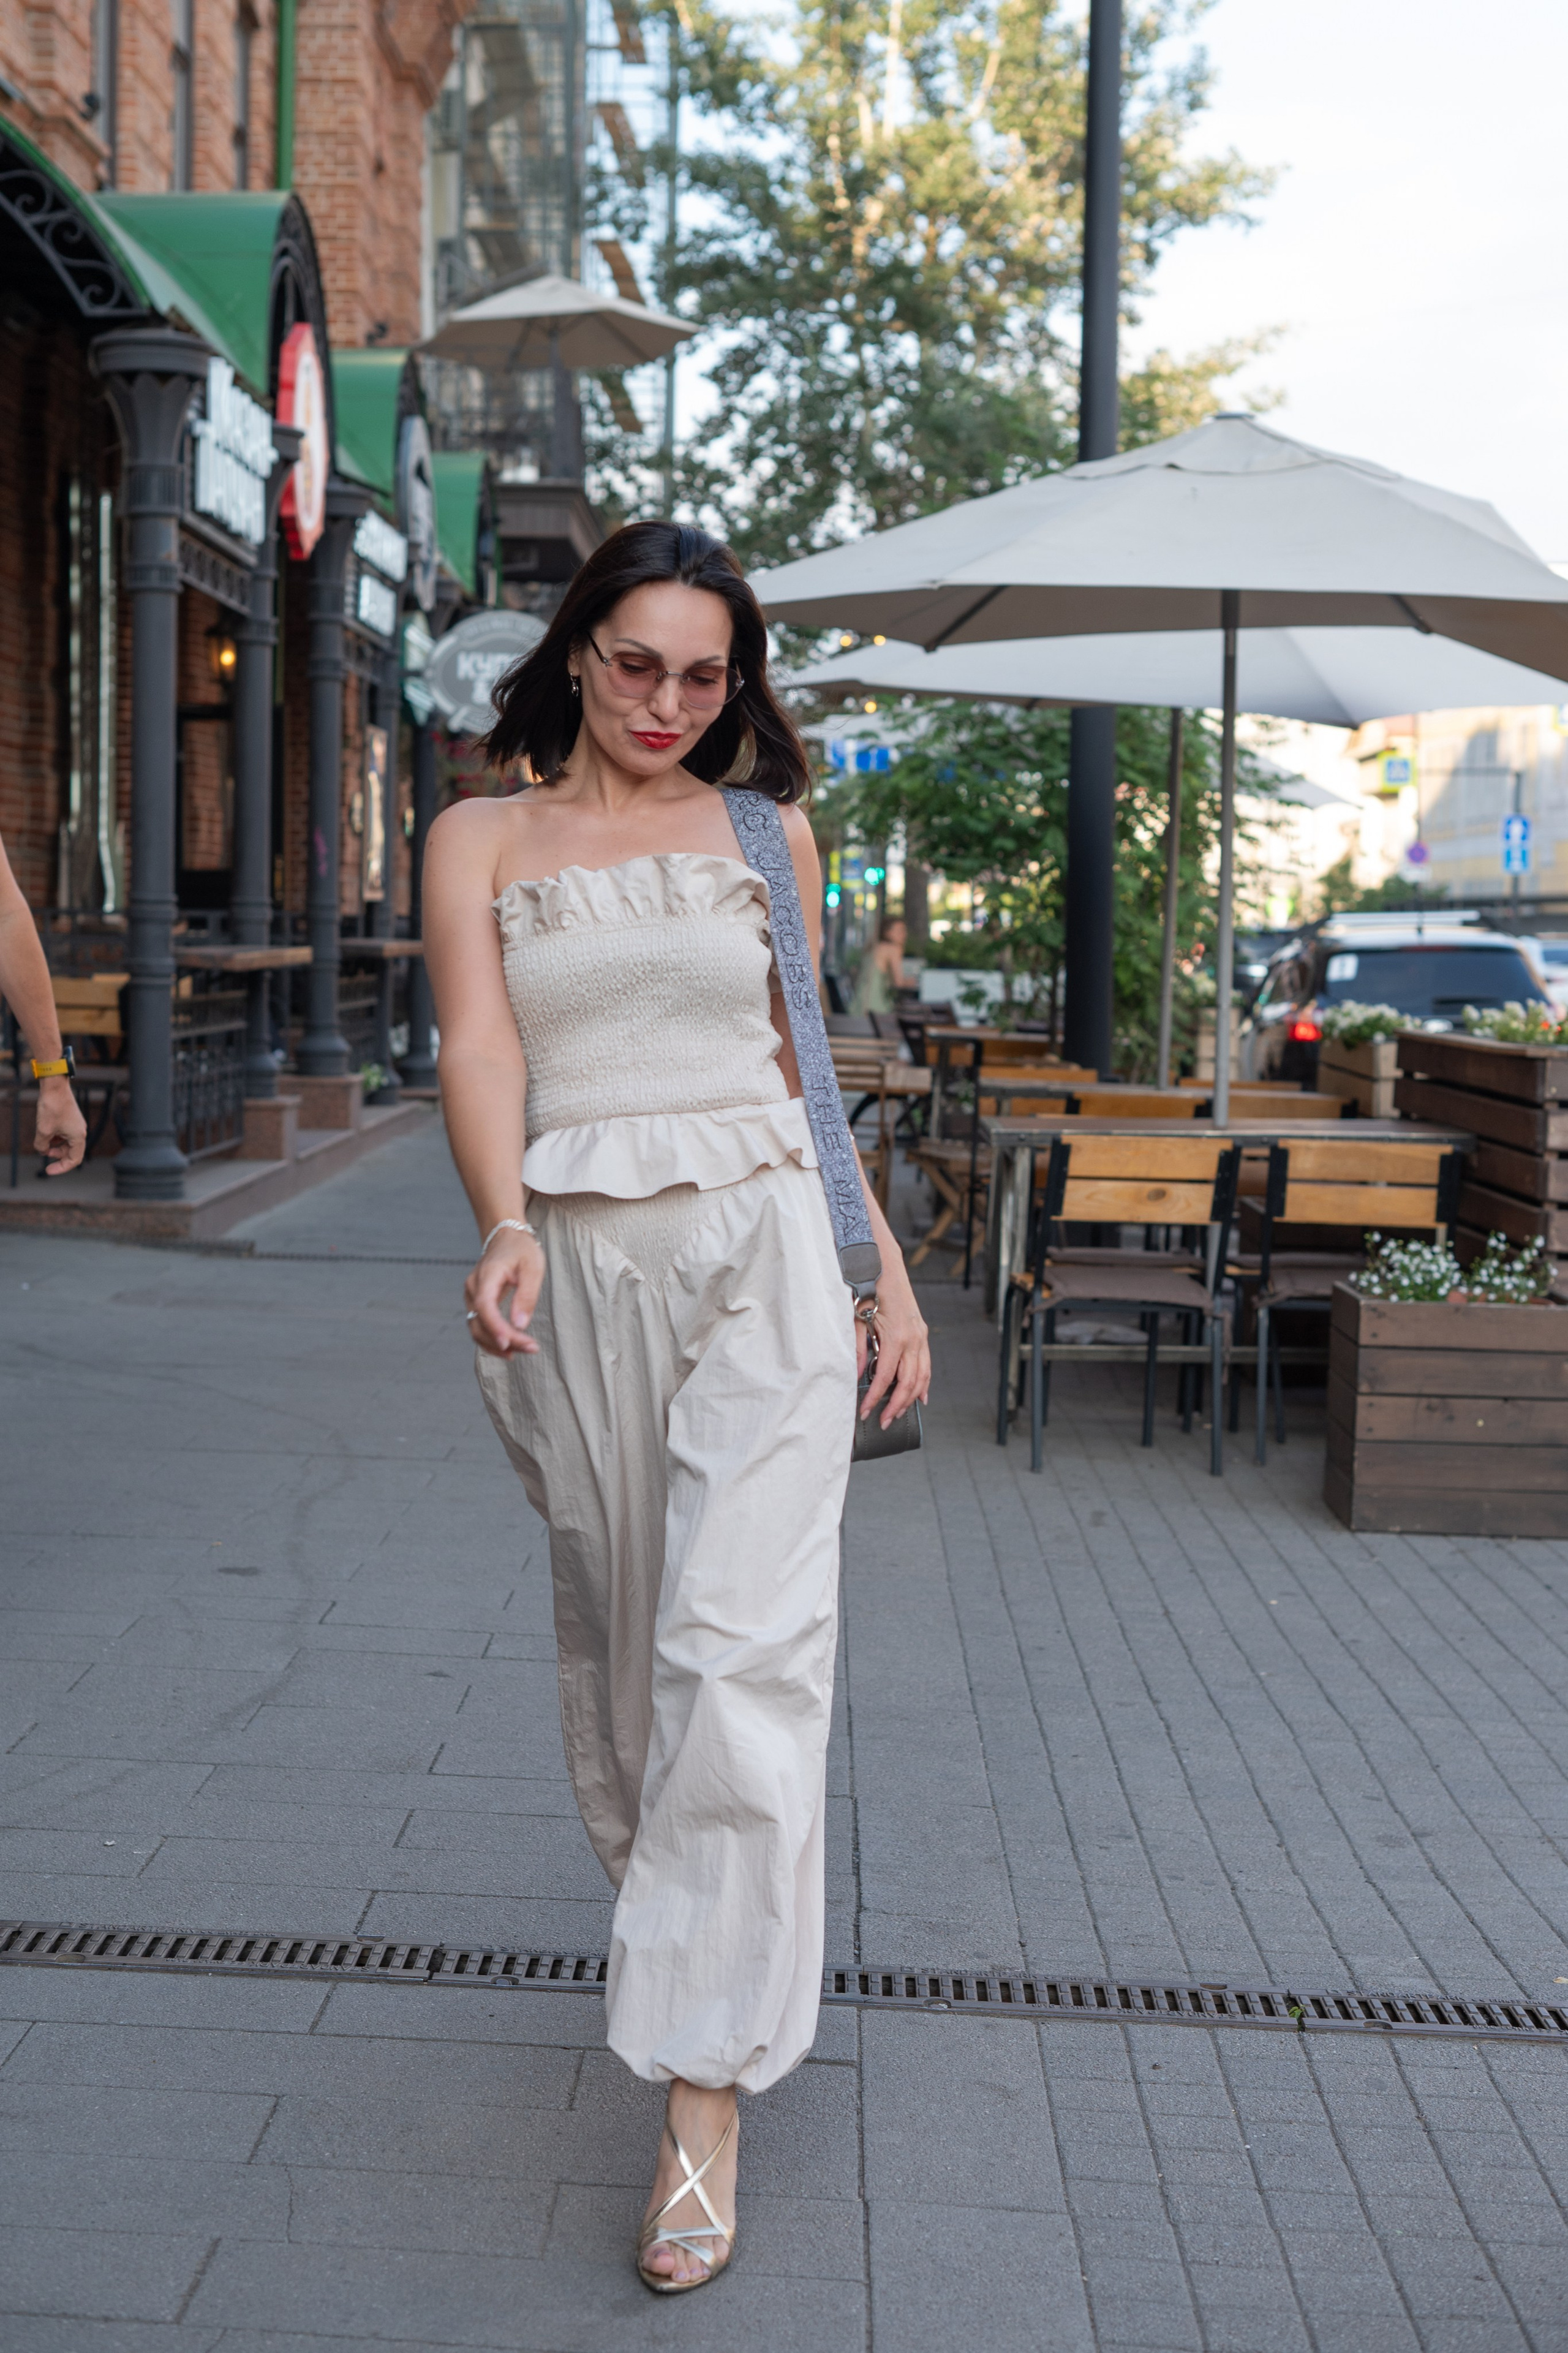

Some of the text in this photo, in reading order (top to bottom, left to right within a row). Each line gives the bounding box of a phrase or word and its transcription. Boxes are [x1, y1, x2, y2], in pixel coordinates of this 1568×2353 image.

[732, 788, 812, 1010] RC JACOBS
[811, 1073, 861, 1244] THE MA
